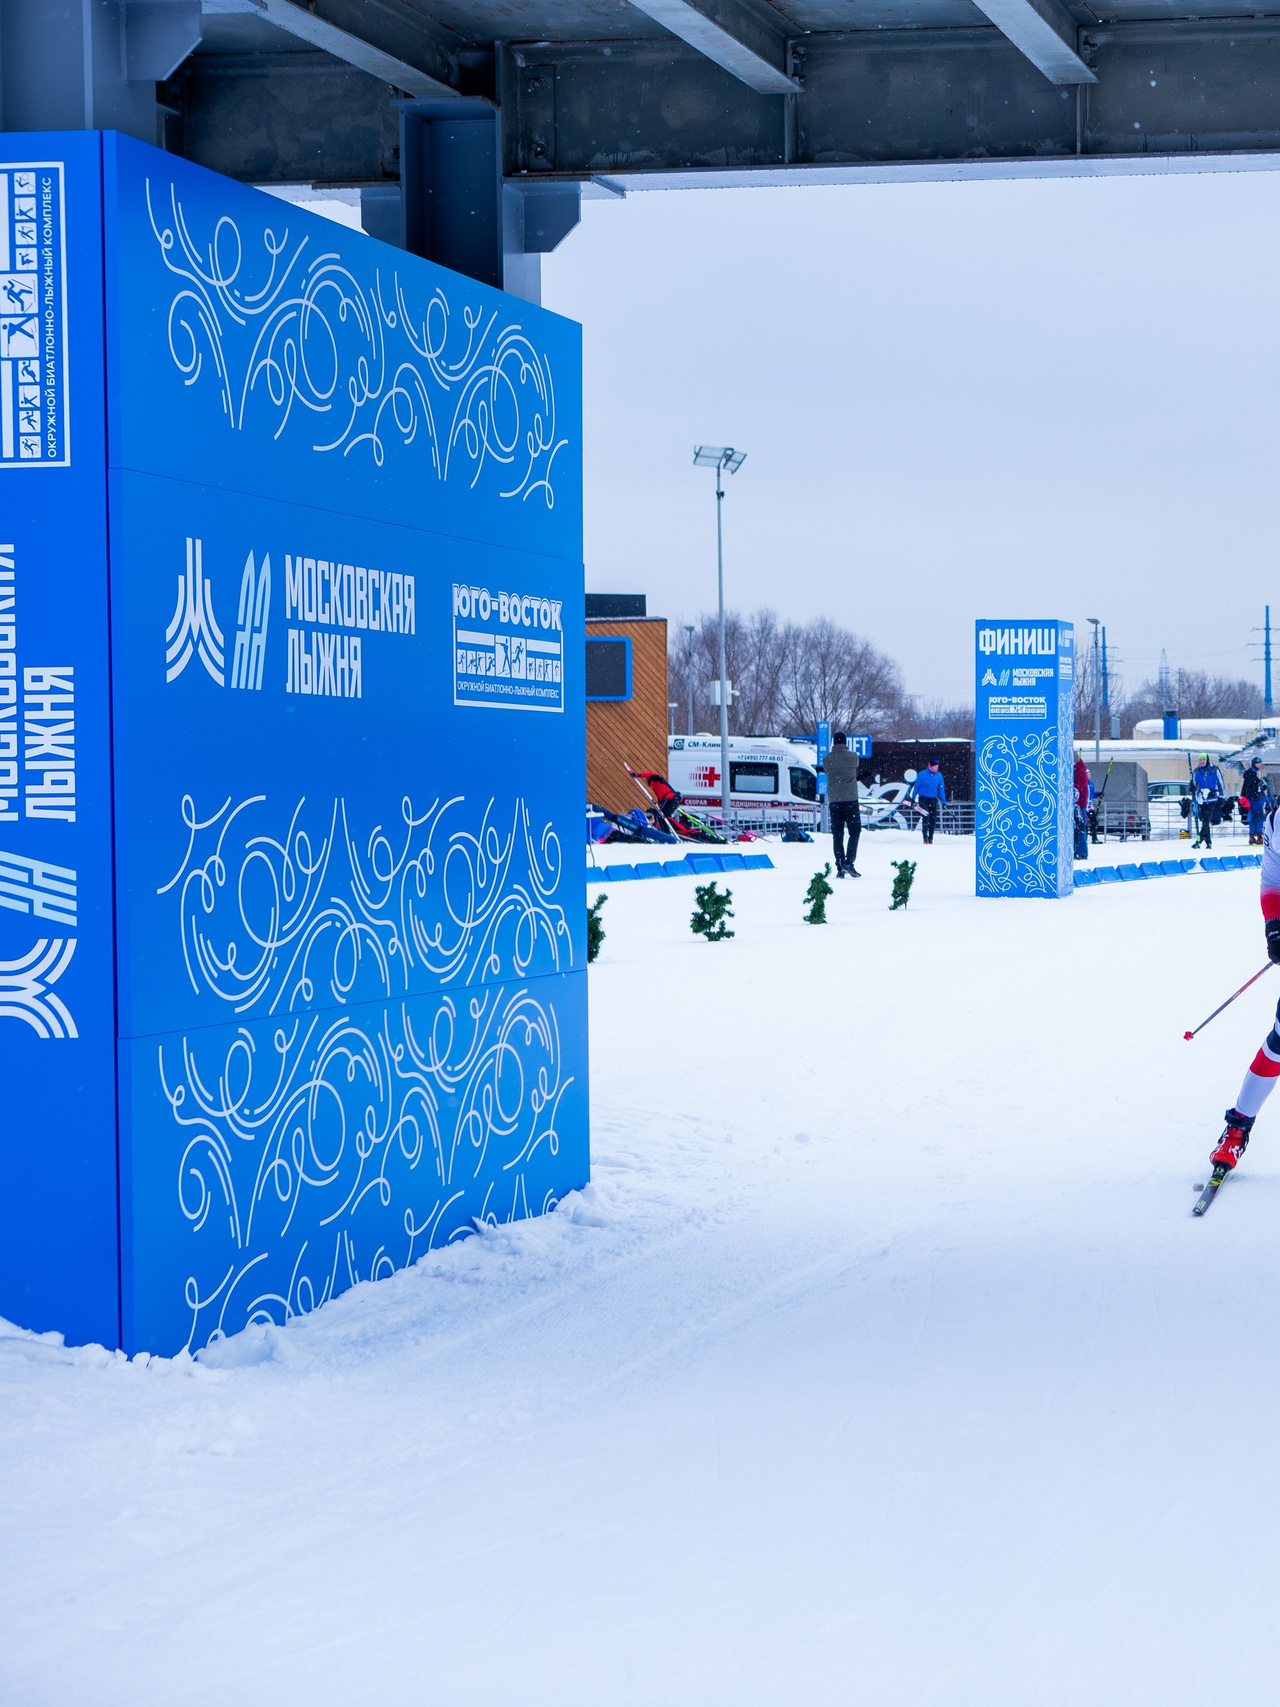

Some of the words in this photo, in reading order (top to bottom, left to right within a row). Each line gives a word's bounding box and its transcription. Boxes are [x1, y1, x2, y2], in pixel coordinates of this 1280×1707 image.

[42, 177, 53, 246] КОМПЛЕКС
[43, 248, 55, 386] БИАТЛОННО-ЛЫЖНЫЙ
[46, 387, 57, 458] ОКРУЖНОЙ
[285, 554, 416, 635] МОСКОВСКАЯ
[452, 583, 563, 631] ЮГО-ВОСТОК
[286, 628, 362, 699] ЛЫЖНЯ
[979, 628, 1056, 655] ФИНИШ
[457, 681, 485, 692] ОКРУЖНОЙ
[485, 684, 536, 697] БИАТЛОННО-ЛЫЖНЫЙ
[536, 688, 560, 699] КОМПЛЕКС
[989, 696, 1046, 704] ЮГО-ВОСТОК
[1012, 668, 1054, 677] МОСКОВСКАЯ
[1012, 677, 1036, 686] ЛЫЖНЯ
[24, 666, 76, 822] ЛЫЖНЯ
